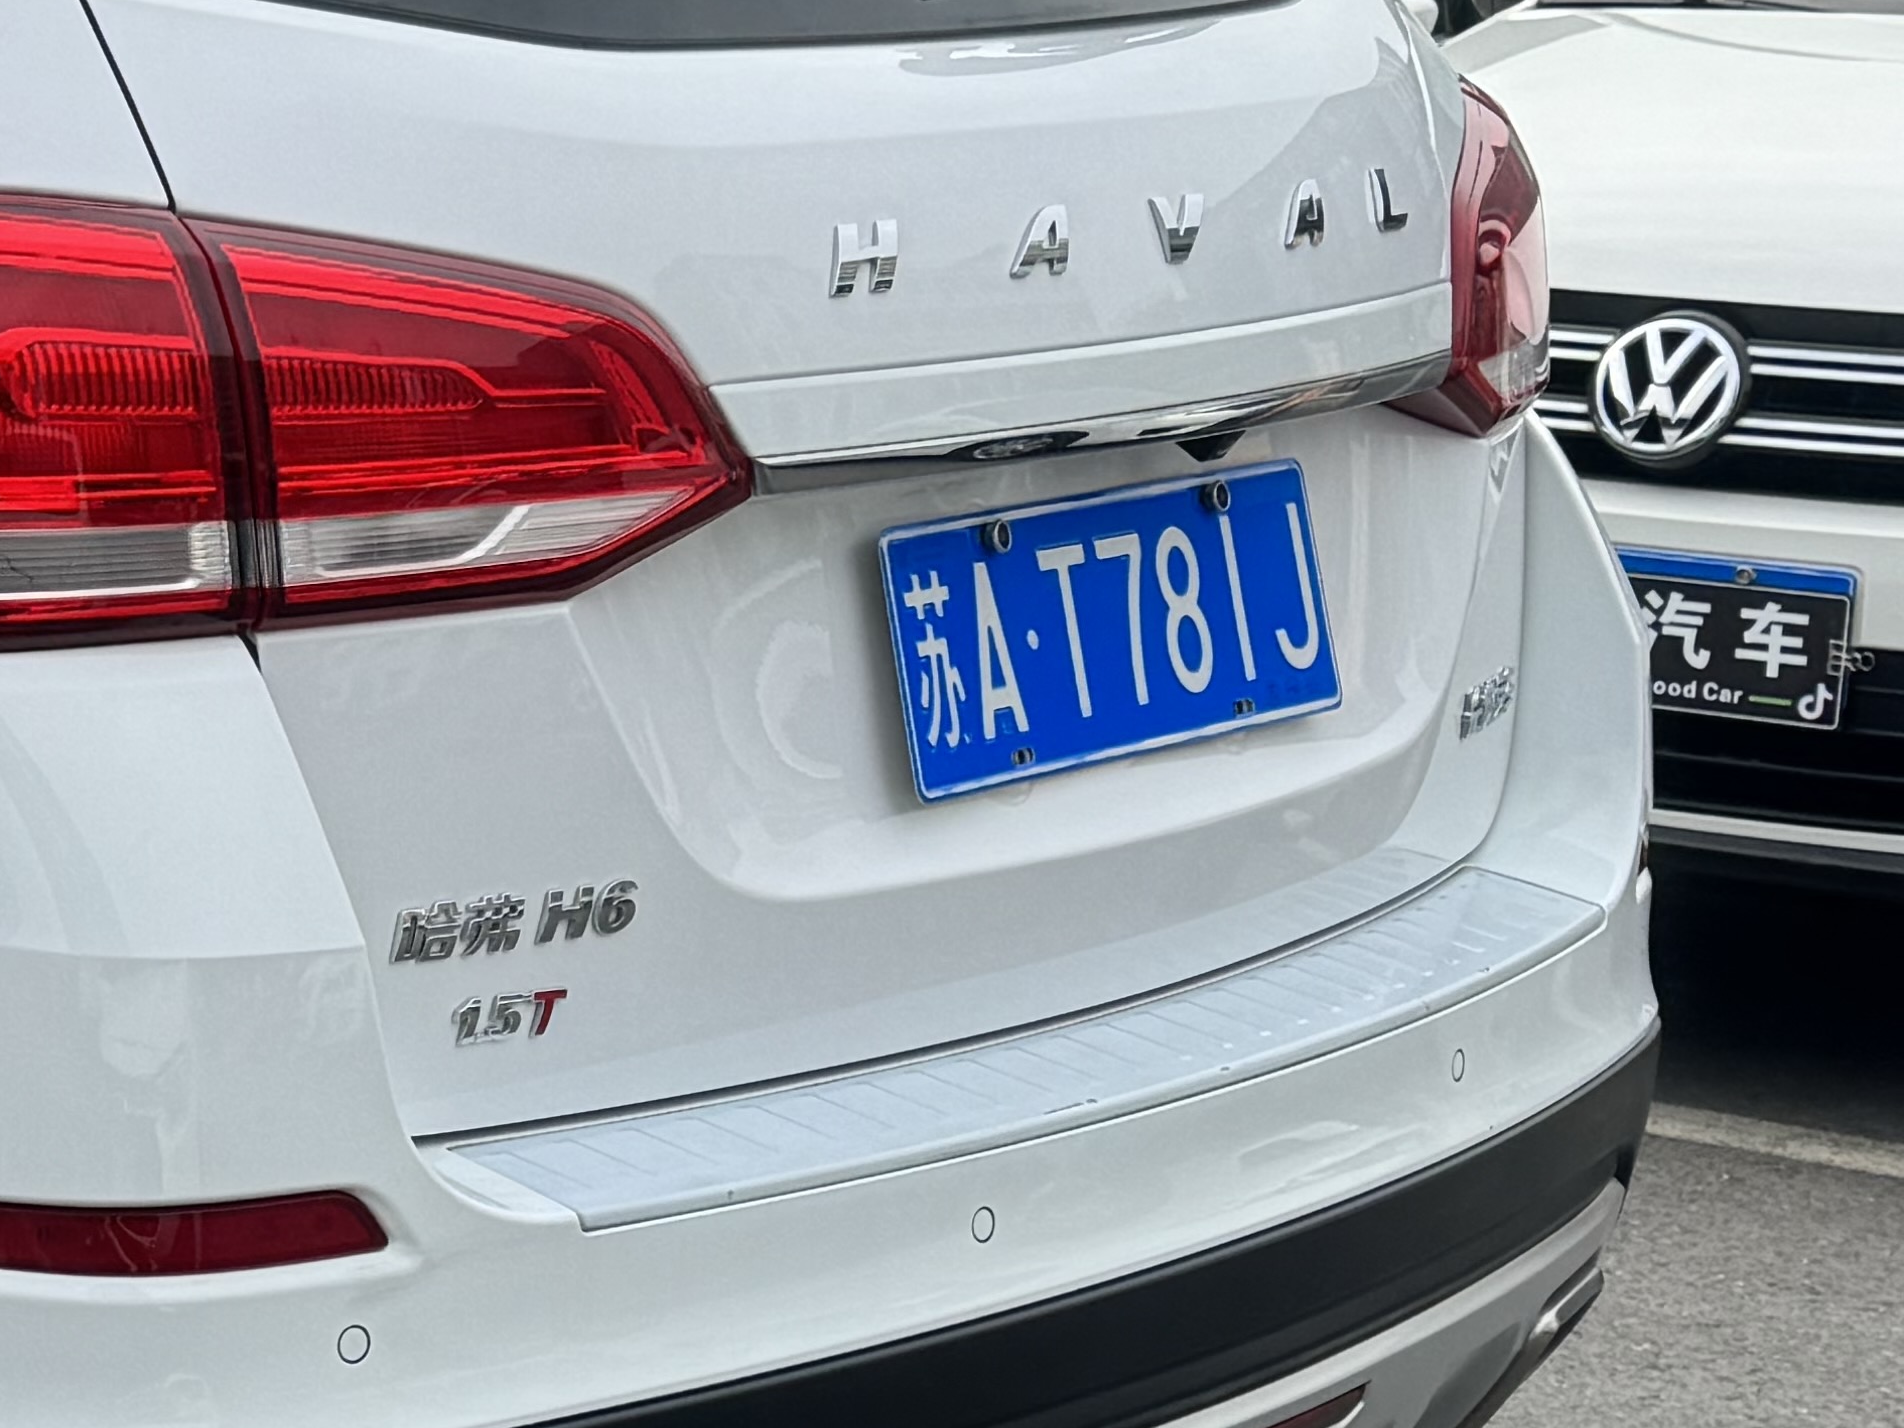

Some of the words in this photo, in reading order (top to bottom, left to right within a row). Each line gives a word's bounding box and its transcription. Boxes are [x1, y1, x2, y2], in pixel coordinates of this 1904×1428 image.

[828, 167, 1408, 299] HAVAL
[1641, 589, 1810, 679] 汽车
[1652, 679, 1697, 699] ood
[1702, 681, 1744, 705] Car
[534, 879, 639, 946] H6
